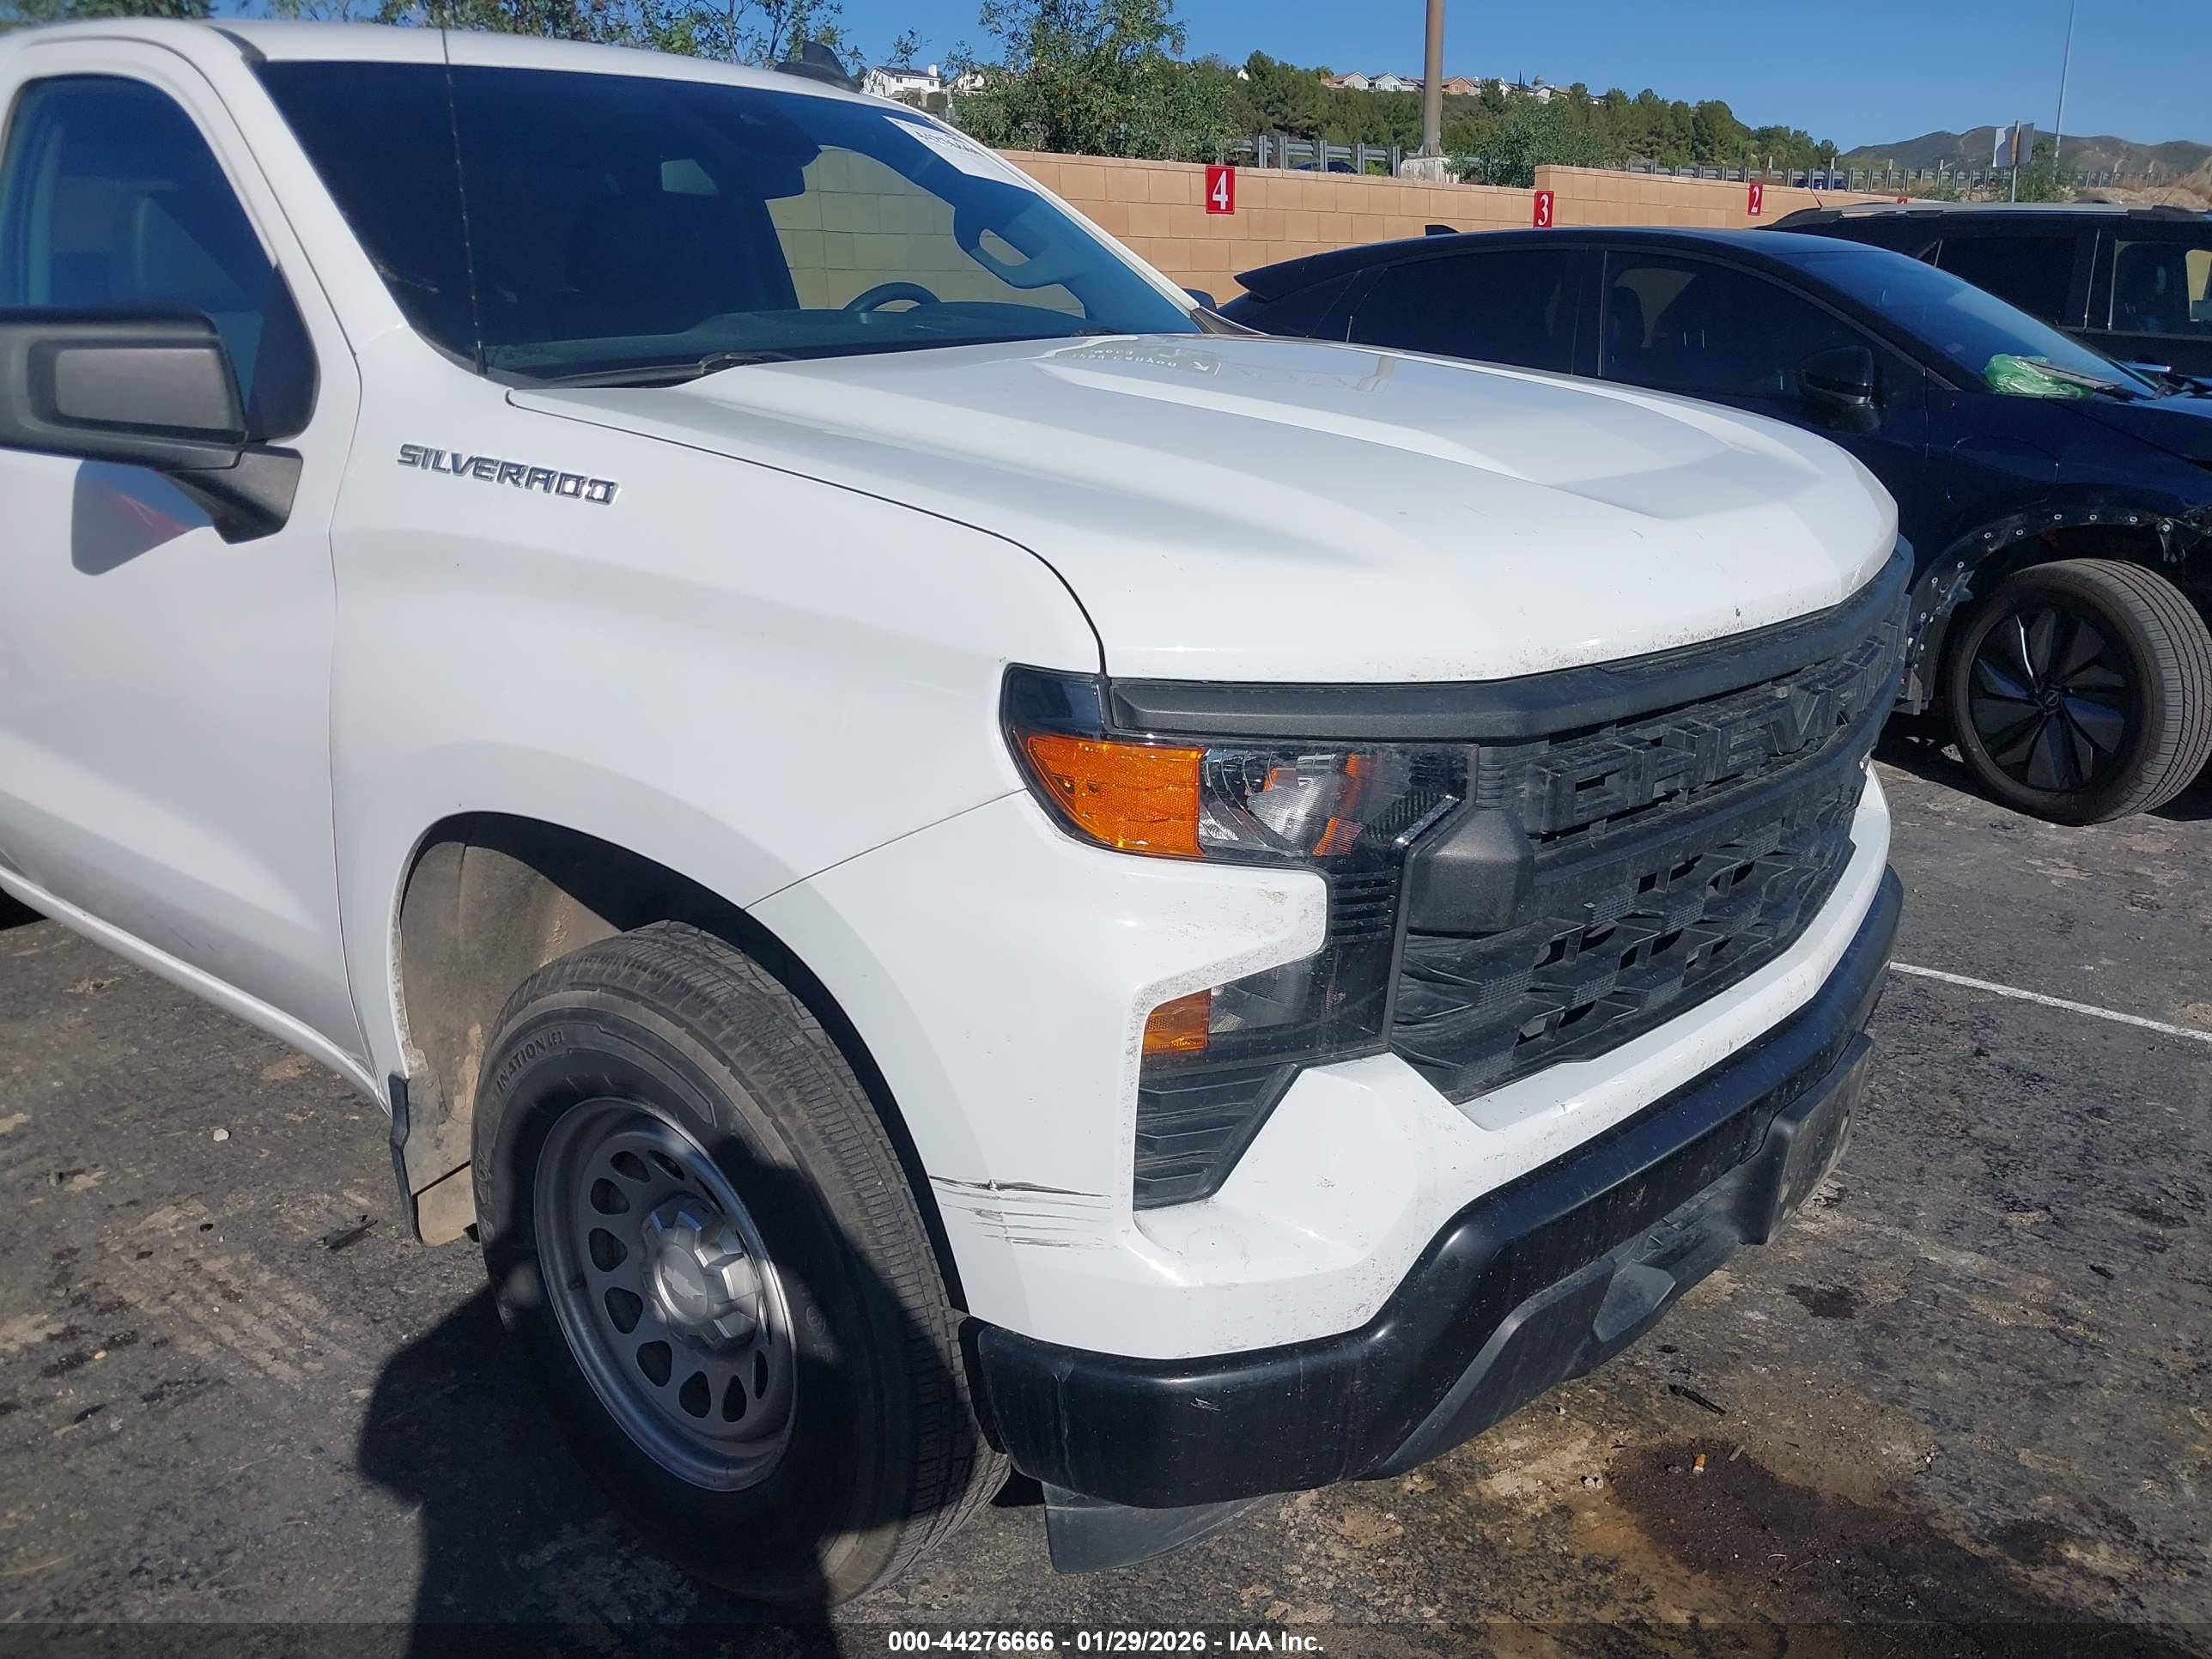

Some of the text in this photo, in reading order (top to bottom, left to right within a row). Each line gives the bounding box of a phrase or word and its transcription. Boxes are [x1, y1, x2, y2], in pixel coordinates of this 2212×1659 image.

[1212, 170, 1228, 210] 4
[1751, 186, 1759, 213] 2
[1538, 194, 1549, 226] 3
[397, 443, 619, 505] SILVERADO
